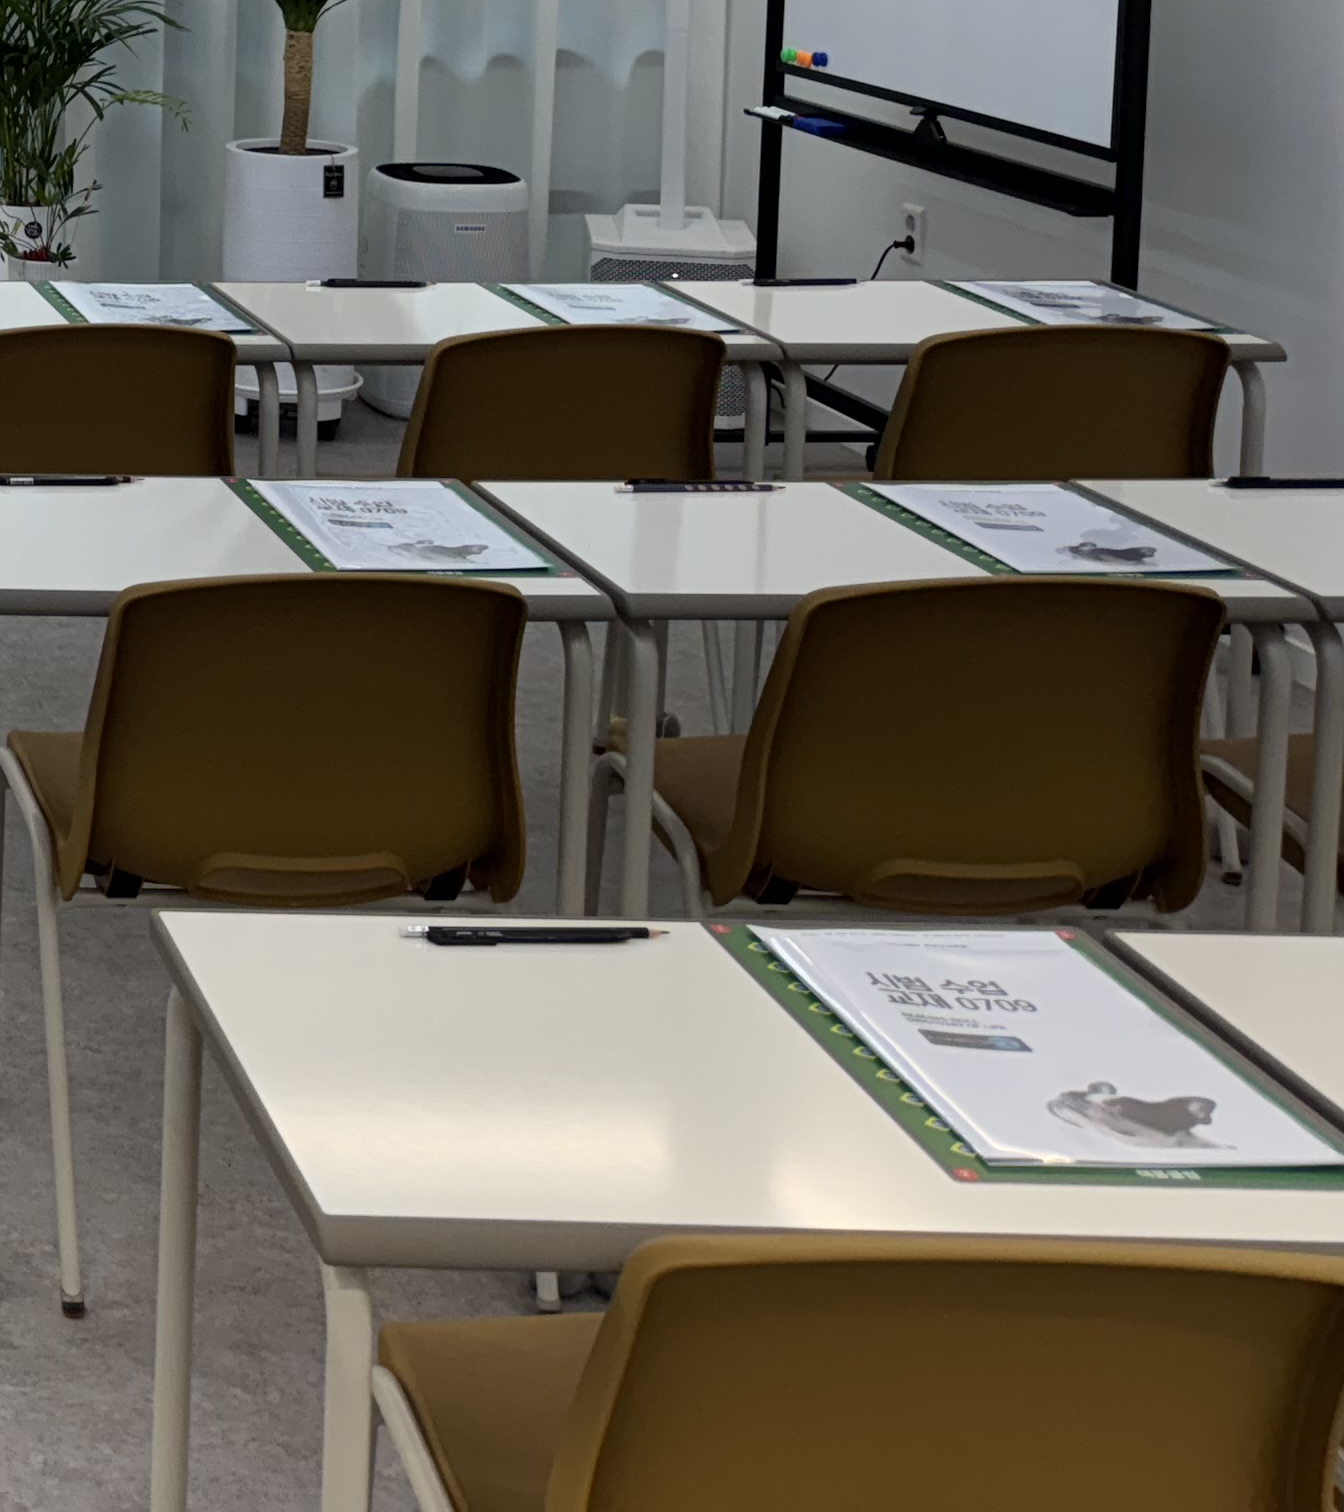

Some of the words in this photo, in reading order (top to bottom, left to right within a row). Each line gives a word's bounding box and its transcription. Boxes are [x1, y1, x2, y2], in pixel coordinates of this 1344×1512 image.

[865, 971, 935, 993] 시범
[940, 978, 1010, 997] 수업
[955, 997, 1039, 1013] 0709
